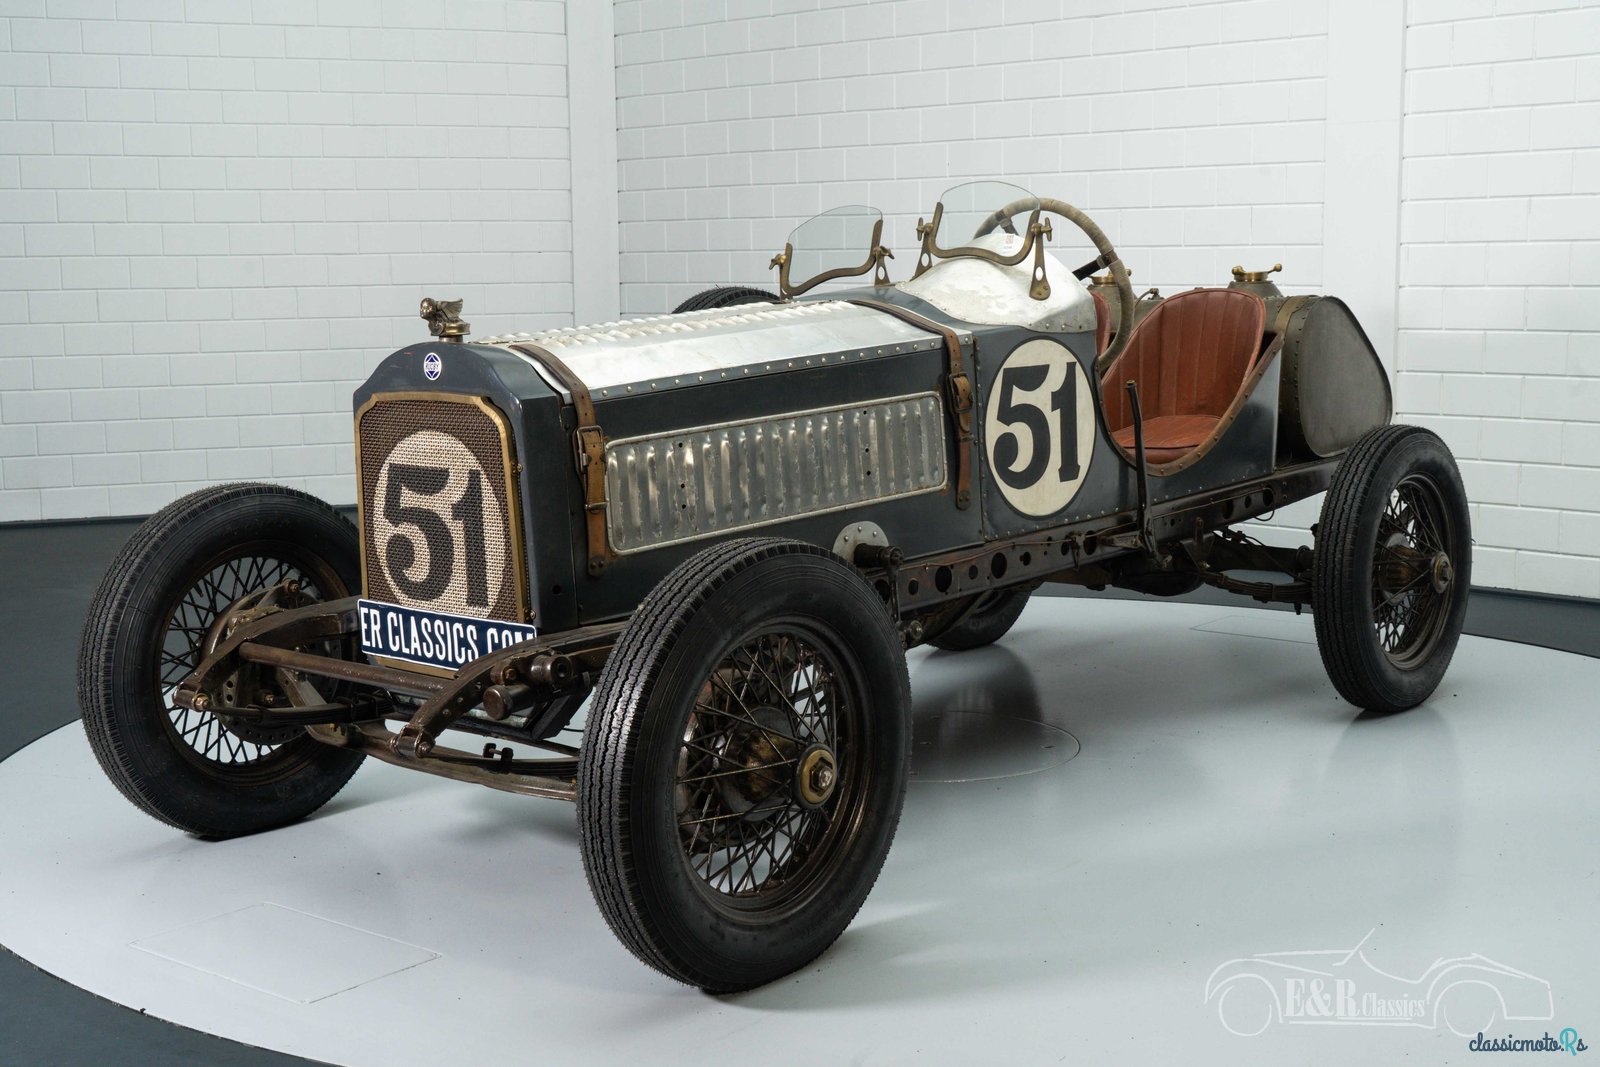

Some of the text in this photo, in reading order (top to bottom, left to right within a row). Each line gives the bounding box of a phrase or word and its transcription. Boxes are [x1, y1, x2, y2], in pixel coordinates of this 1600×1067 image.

[993, 361, 1081, 490] 51
[383, 462, 489, 608] 51
[360, 607, 383, 649] ER
[387, 611, 479, 664] CLASSICS
